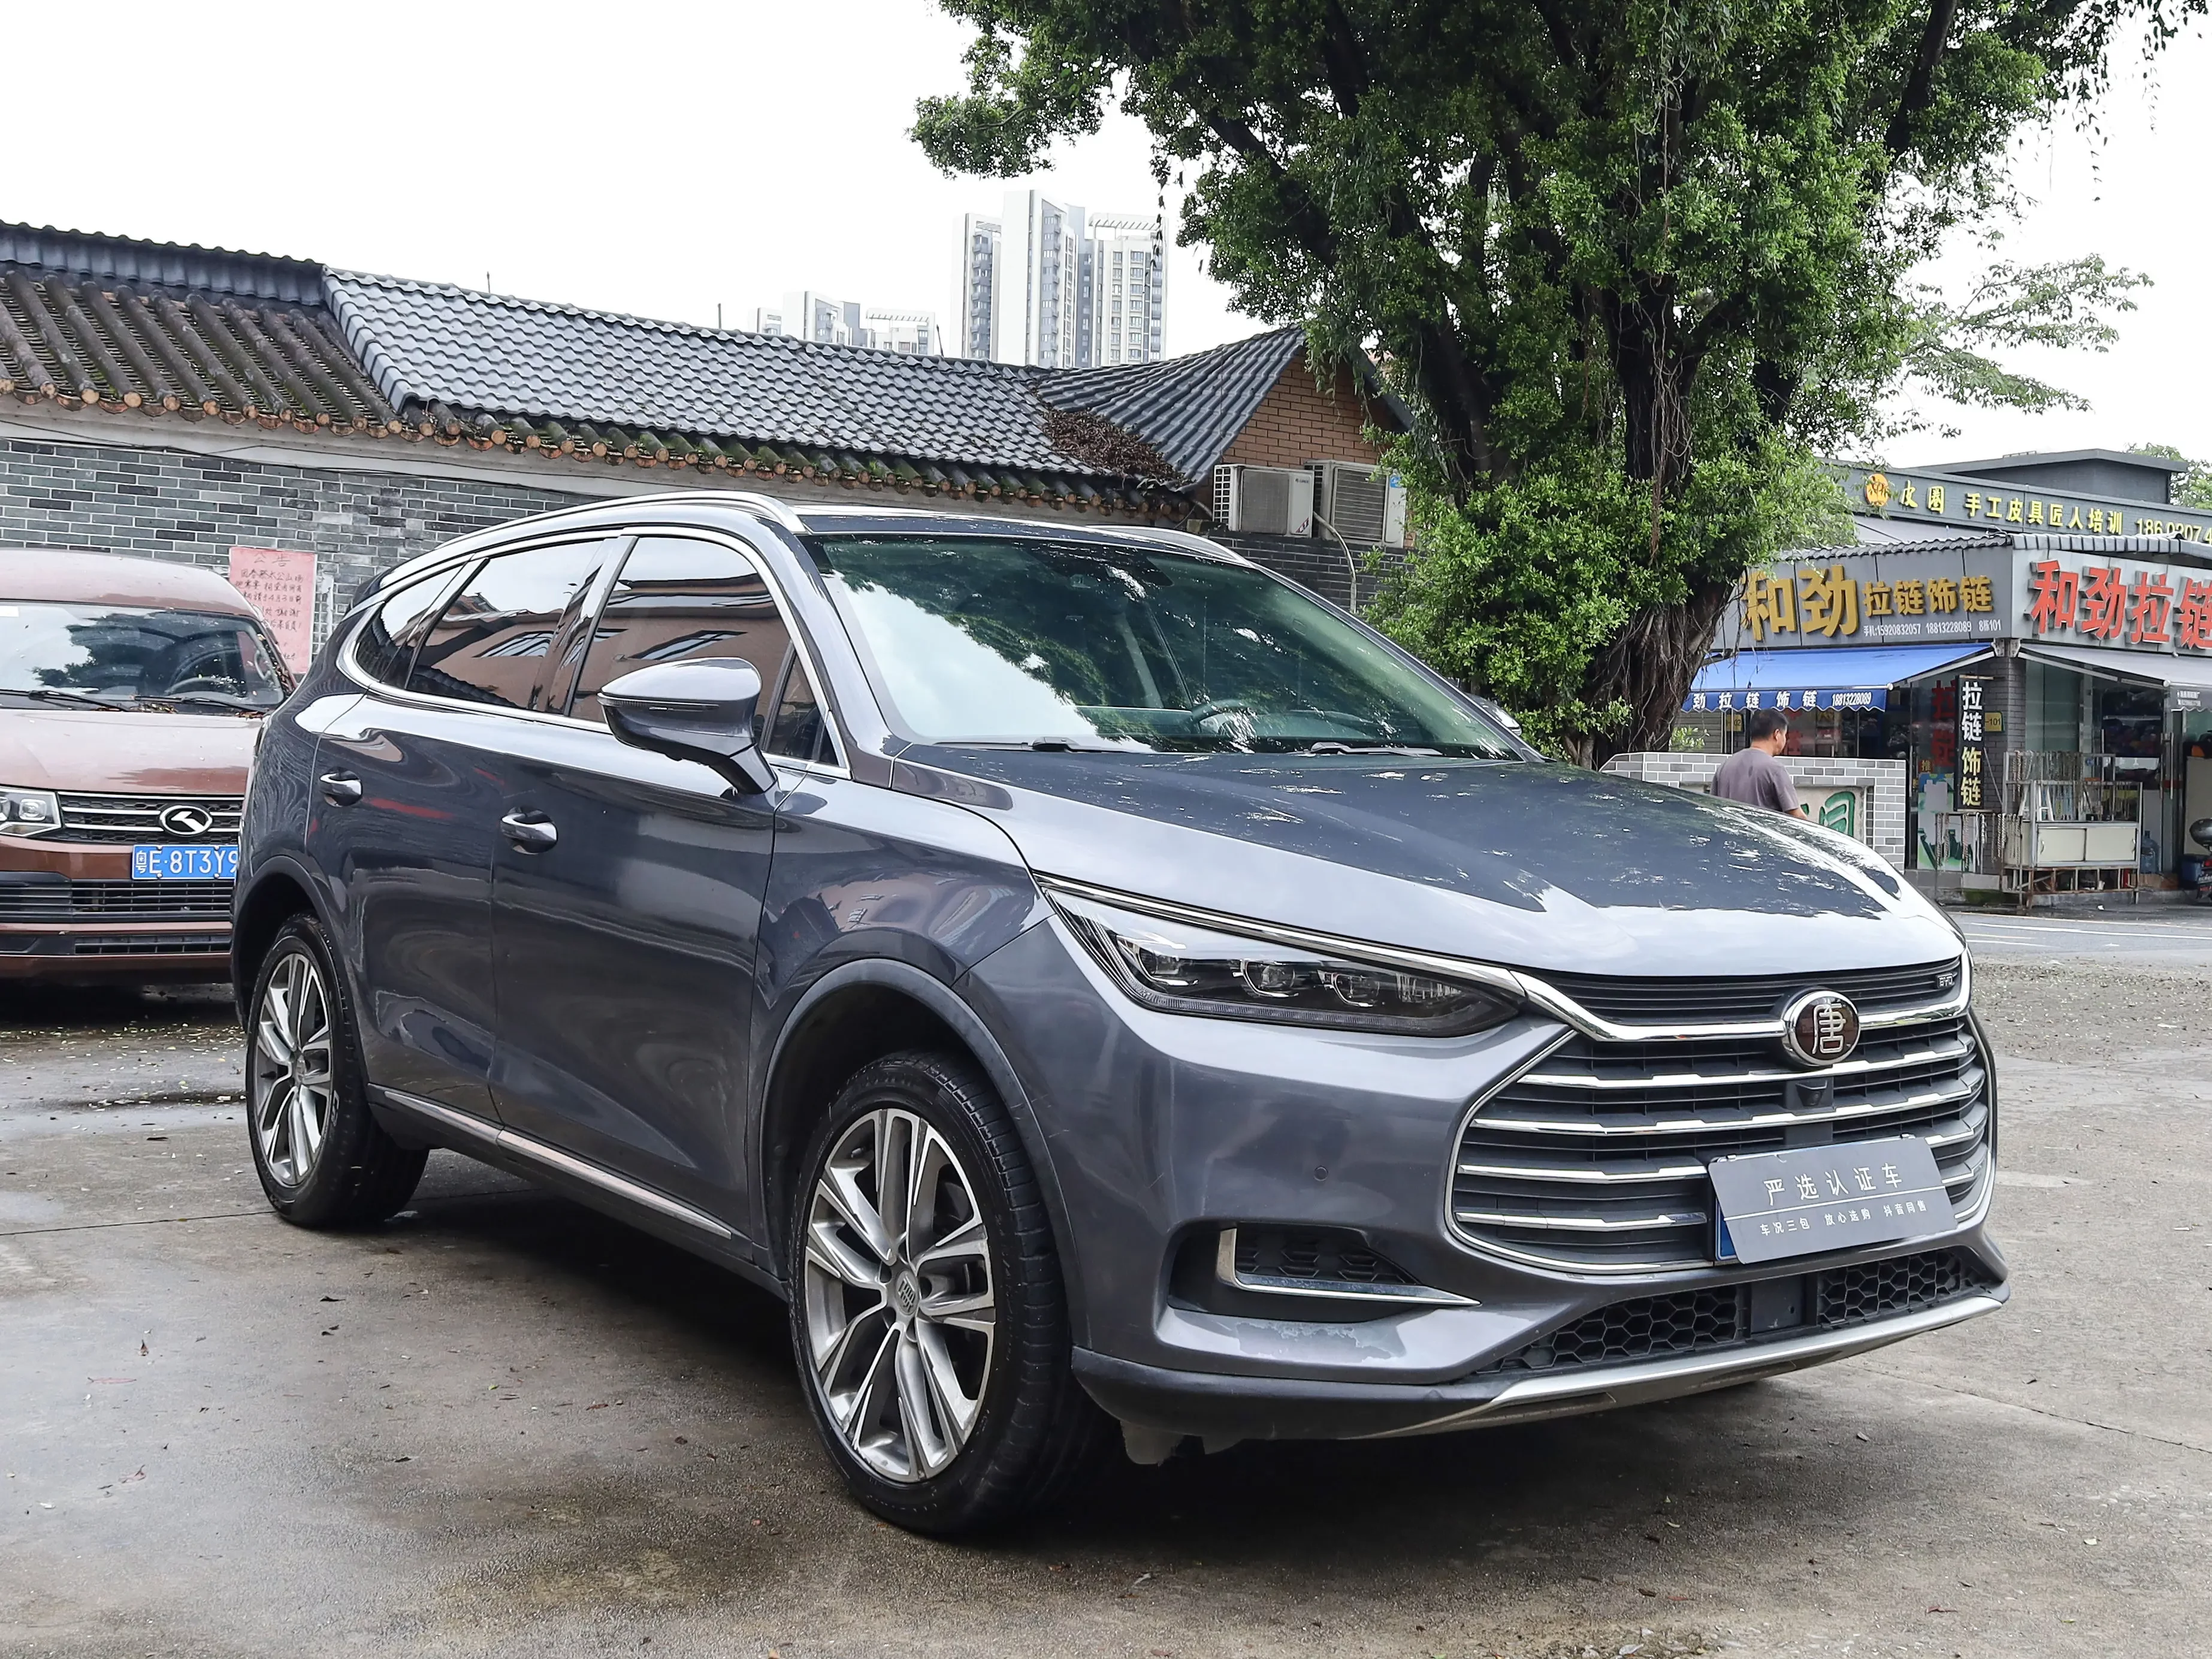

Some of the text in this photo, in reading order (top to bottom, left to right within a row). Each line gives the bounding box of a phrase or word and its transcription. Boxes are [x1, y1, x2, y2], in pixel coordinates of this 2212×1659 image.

[1965, 492, 2123, 535] 手工皮具匠人培训
[1740, 564, 1993, 641] 和劲 拉链饰链
[2030, 560, 2212, 649] 和劲拉链
[1926, 621, 1972, 634] 18813228089
[1832, 692, 1872, 707] 18813228089
[1961, 681, 1983, 806] 拉链饰链
[1812, 999, 1846, 1054] 唐
[1763, 1162, 1902, 1206] 严选认证车
[1760, 1200, 1927, 1236] 车况三包 放心选购 抖音同售
